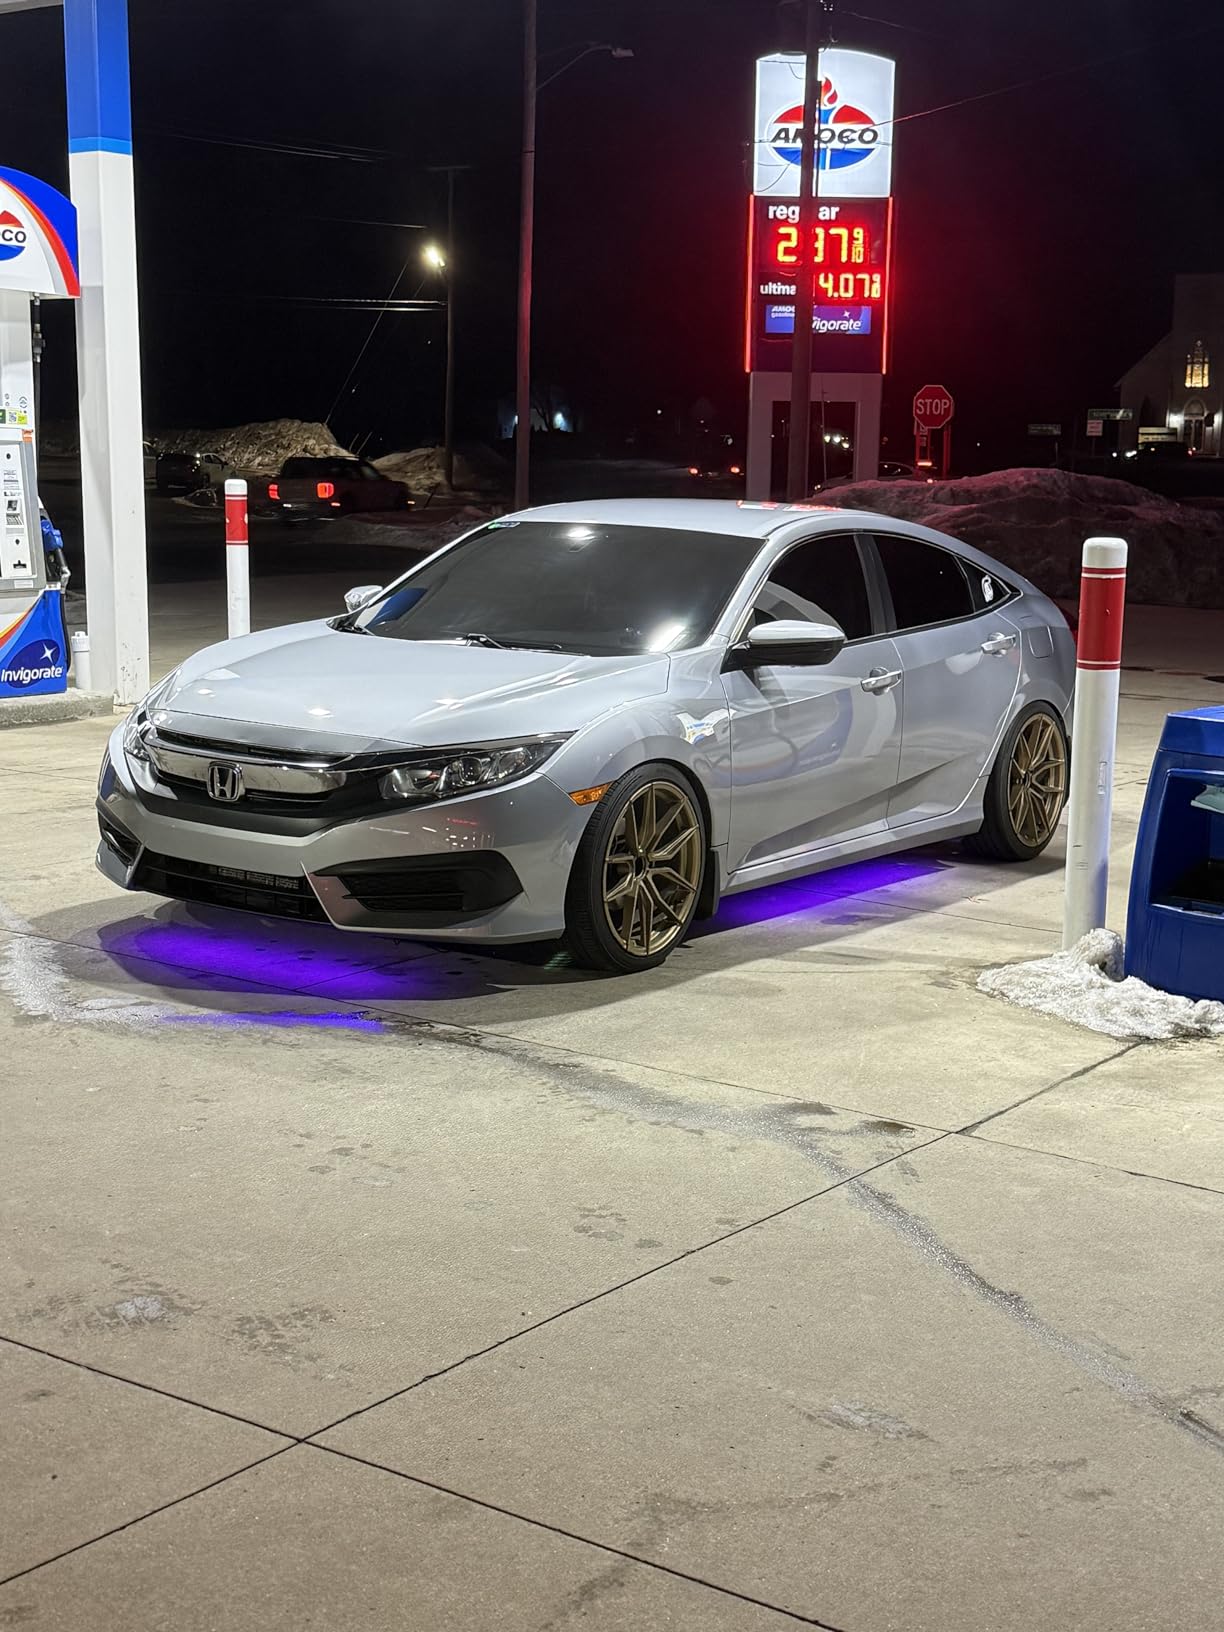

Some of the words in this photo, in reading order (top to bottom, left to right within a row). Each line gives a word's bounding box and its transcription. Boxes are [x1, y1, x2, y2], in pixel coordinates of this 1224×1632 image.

[768, 205, 840, 224] regar
[0, 229, 27, 243] CO
[760, 282, 797, 295] ultima
[812, 317, 862, 333] igorate
[916, 399, 950, 415] STOP
[1, 665, 63, 684] Invigorate
